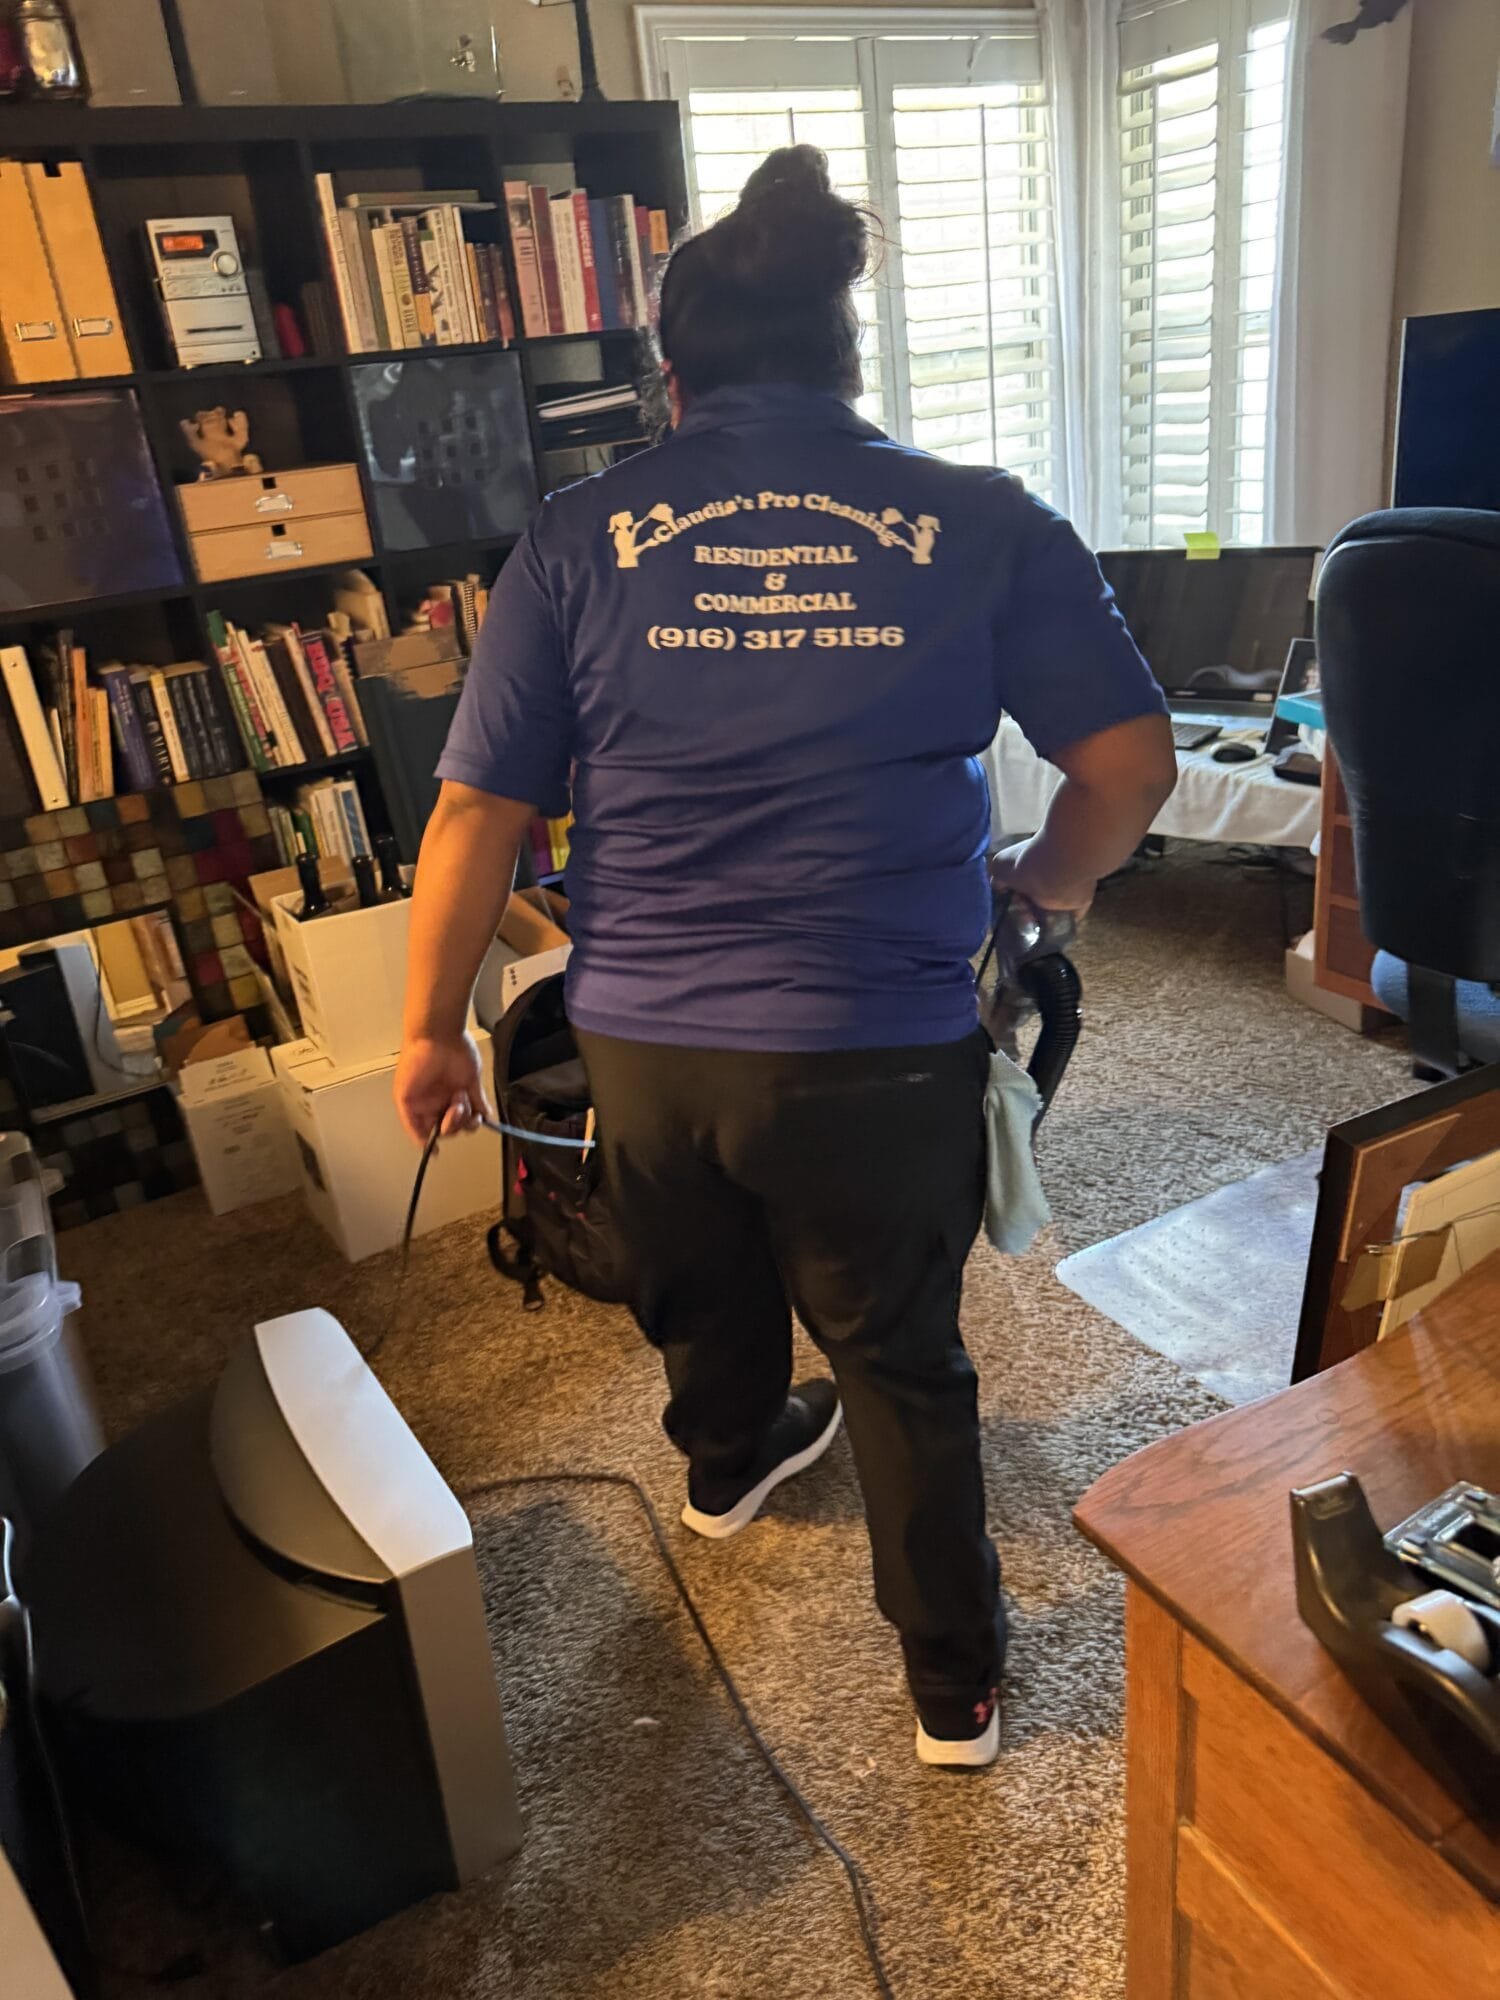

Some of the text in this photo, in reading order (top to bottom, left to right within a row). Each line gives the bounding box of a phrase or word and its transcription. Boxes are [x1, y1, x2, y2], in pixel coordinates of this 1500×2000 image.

[653, 494, 754, 543] Claudia's
[757, 491, 801, 510] Pro
[694, 545, 859, 567] RESIDENTIAL
[763, 572, 788, 592] &
[694, 592, 858, 615] COMMERCIAL
[647, 625, 905, 650] (916) 317 5156
